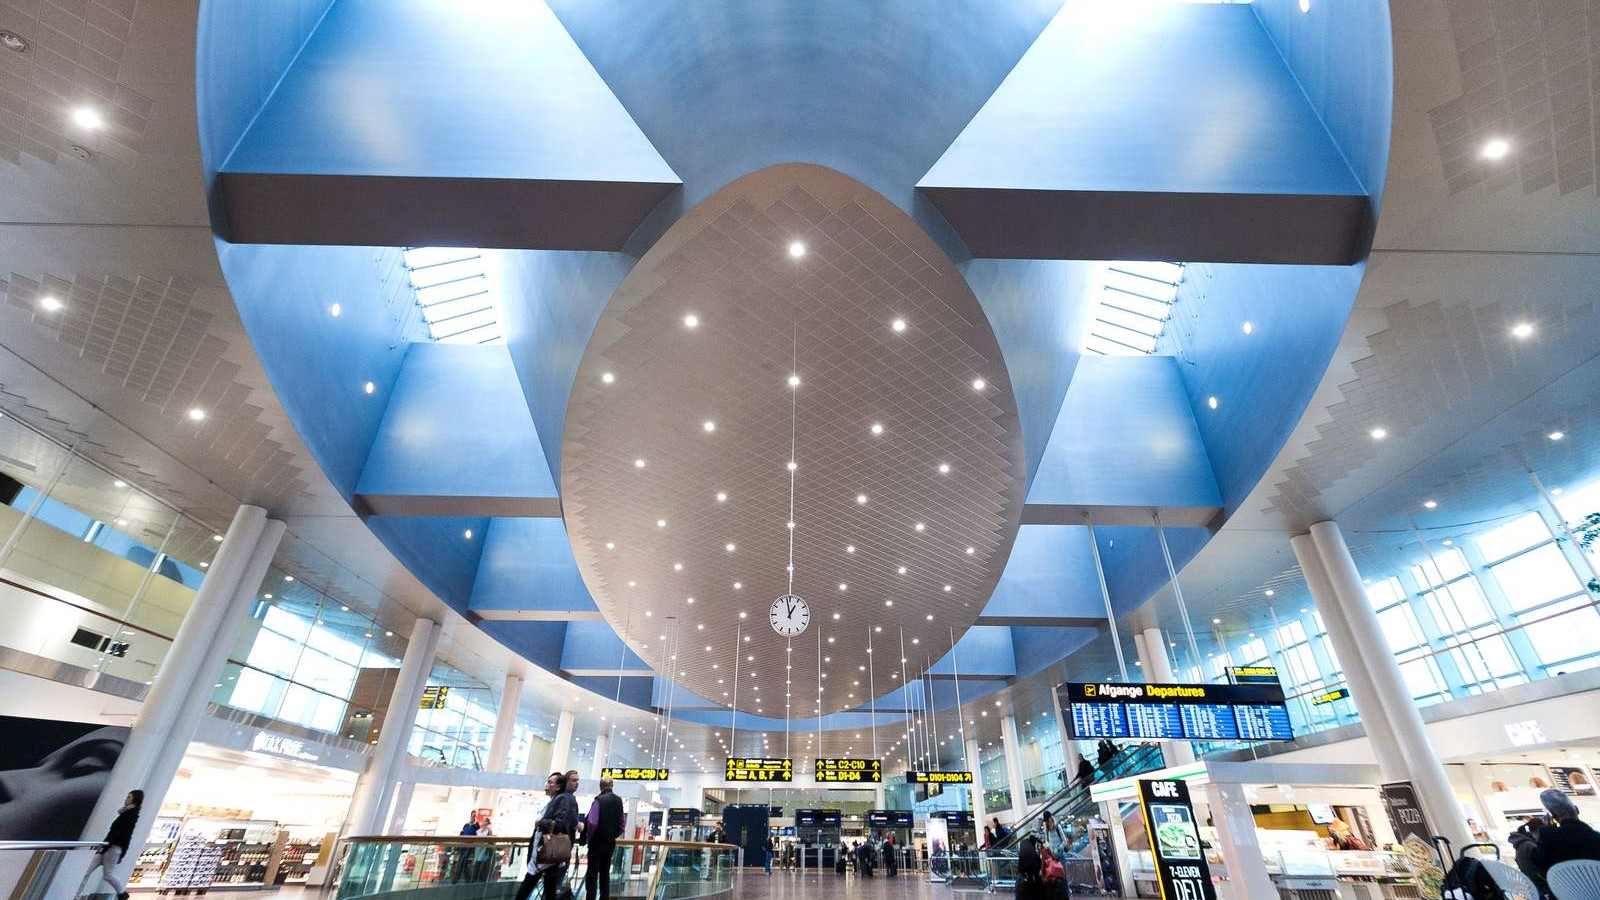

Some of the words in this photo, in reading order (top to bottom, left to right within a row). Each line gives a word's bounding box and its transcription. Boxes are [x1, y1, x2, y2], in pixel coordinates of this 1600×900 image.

[1098, 684, 1143, 698] Afgange
[1146, 685, 1205, 698] Departures
[838, 760, 866, 770] C2-C10
[838, 771, 861, 781] D1-D4
[1151, 781, 1179, 797] CAFE
[1169, 866, 1201, 878] 7-ELEVEN
